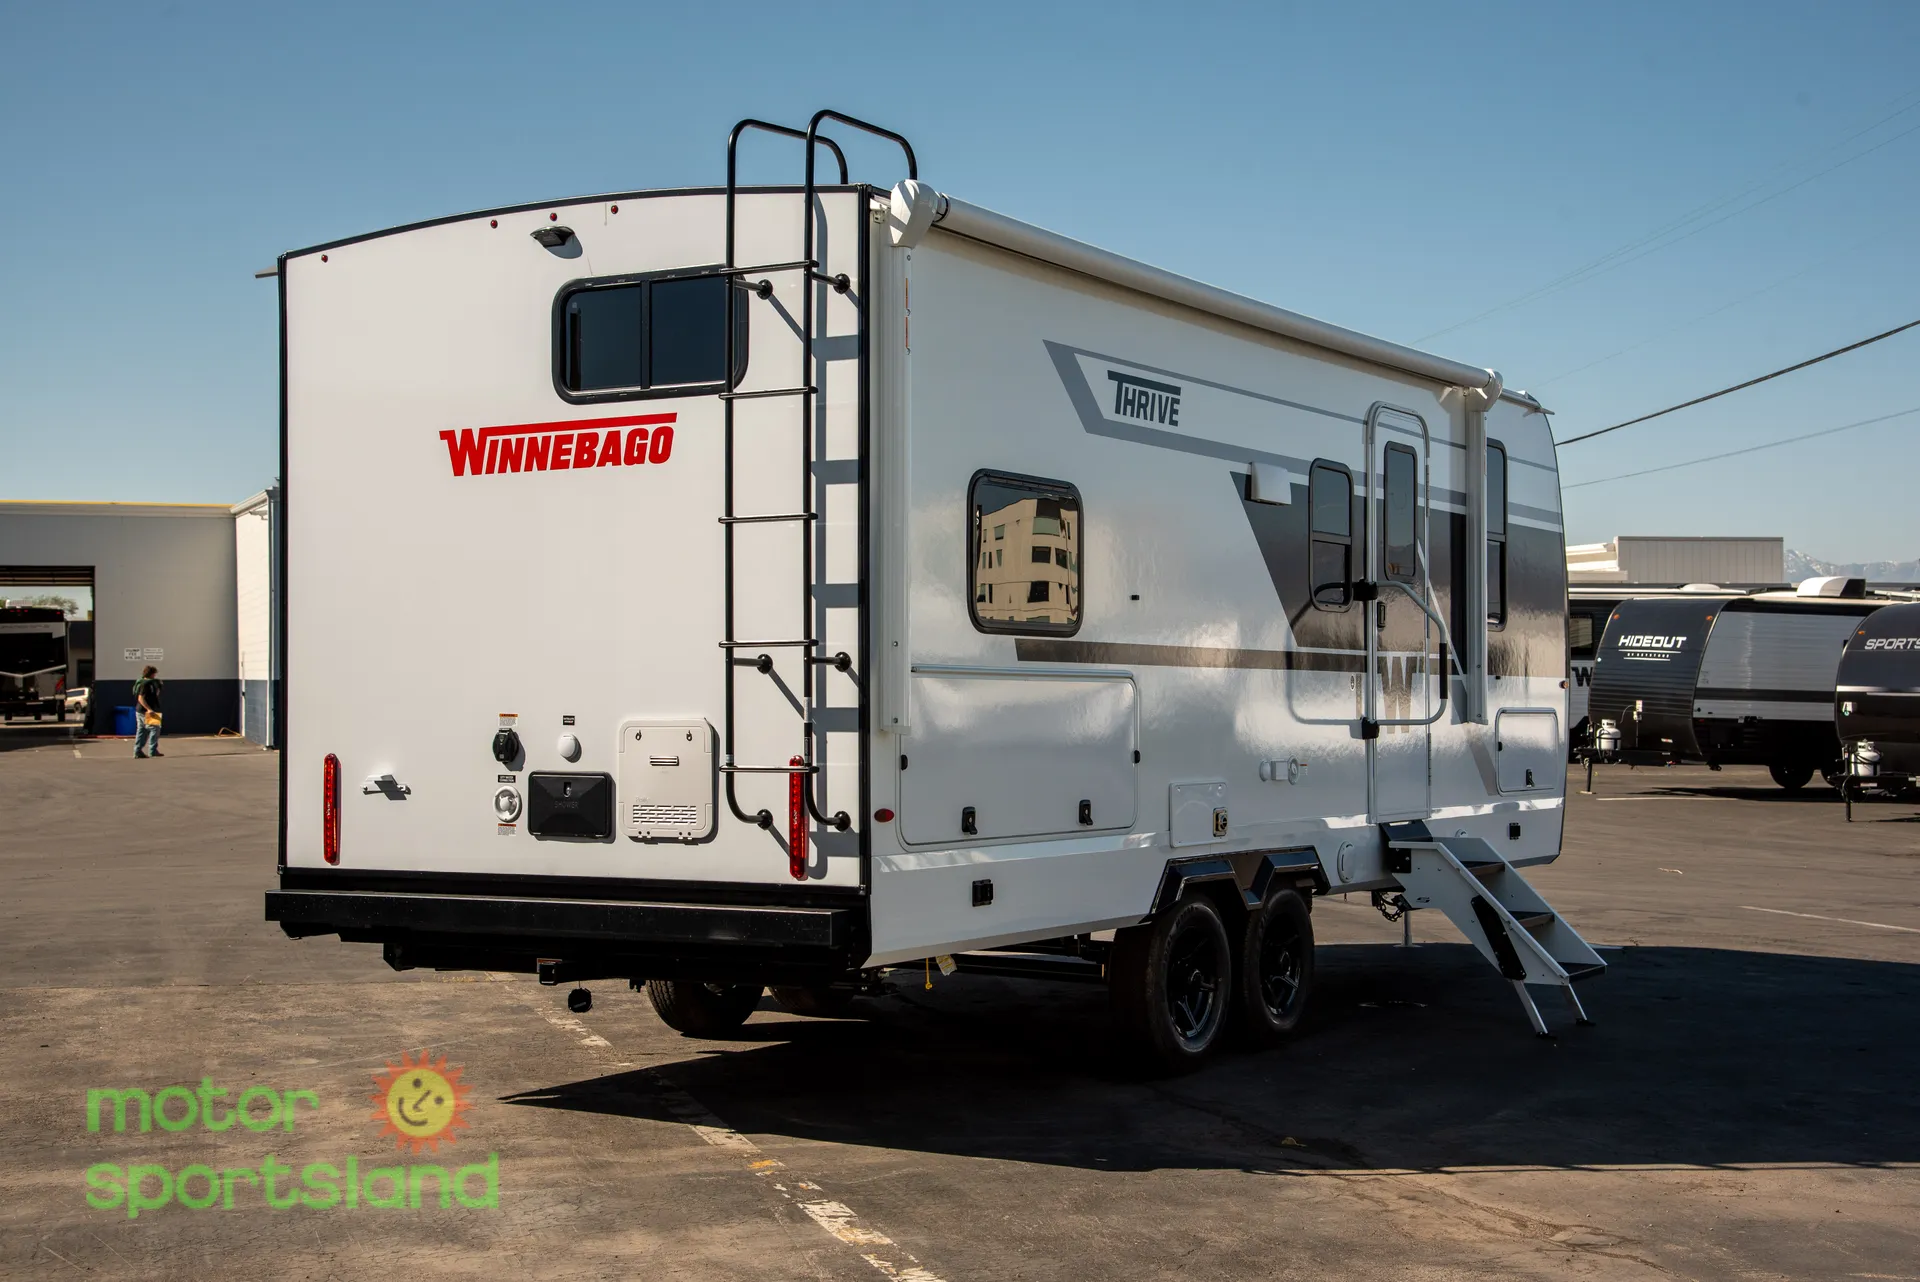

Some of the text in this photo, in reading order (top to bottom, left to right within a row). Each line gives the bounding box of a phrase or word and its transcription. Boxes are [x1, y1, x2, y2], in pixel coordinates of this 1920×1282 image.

[1107, 370, 1181, 427] THRIVE
[439, 412, 677, 476] WINNEBAGO
[1618, 635, 1687, 649] HIDEOUT
[554, 800, 580, 809] SHOWER
